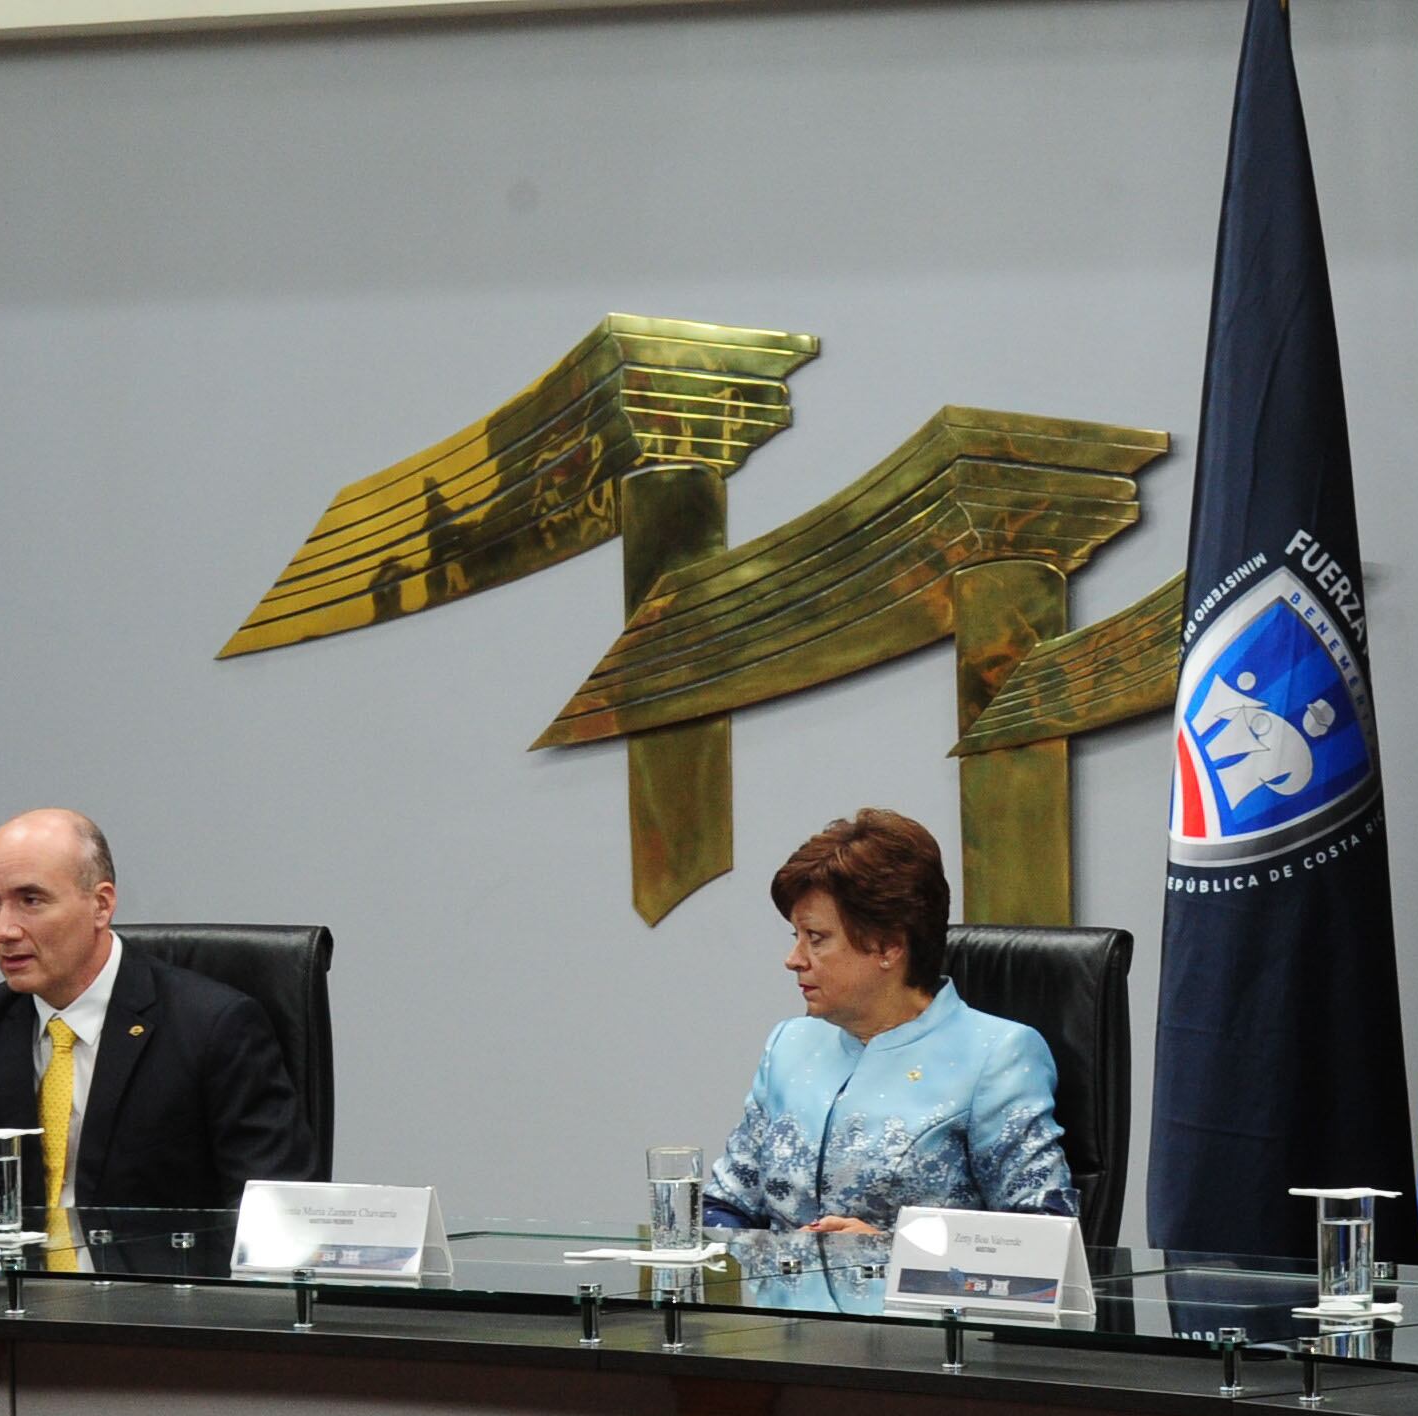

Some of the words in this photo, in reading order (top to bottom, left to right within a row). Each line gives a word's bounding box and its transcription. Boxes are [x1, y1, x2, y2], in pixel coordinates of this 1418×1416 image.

[1194, 552, 1268, 622] MINISTERIO
[1167, 874, 1259, 893] EPÚBLICA
[1269, 864, 1293, 882] DE
[1303, 834, 1360, 870] COSTA
